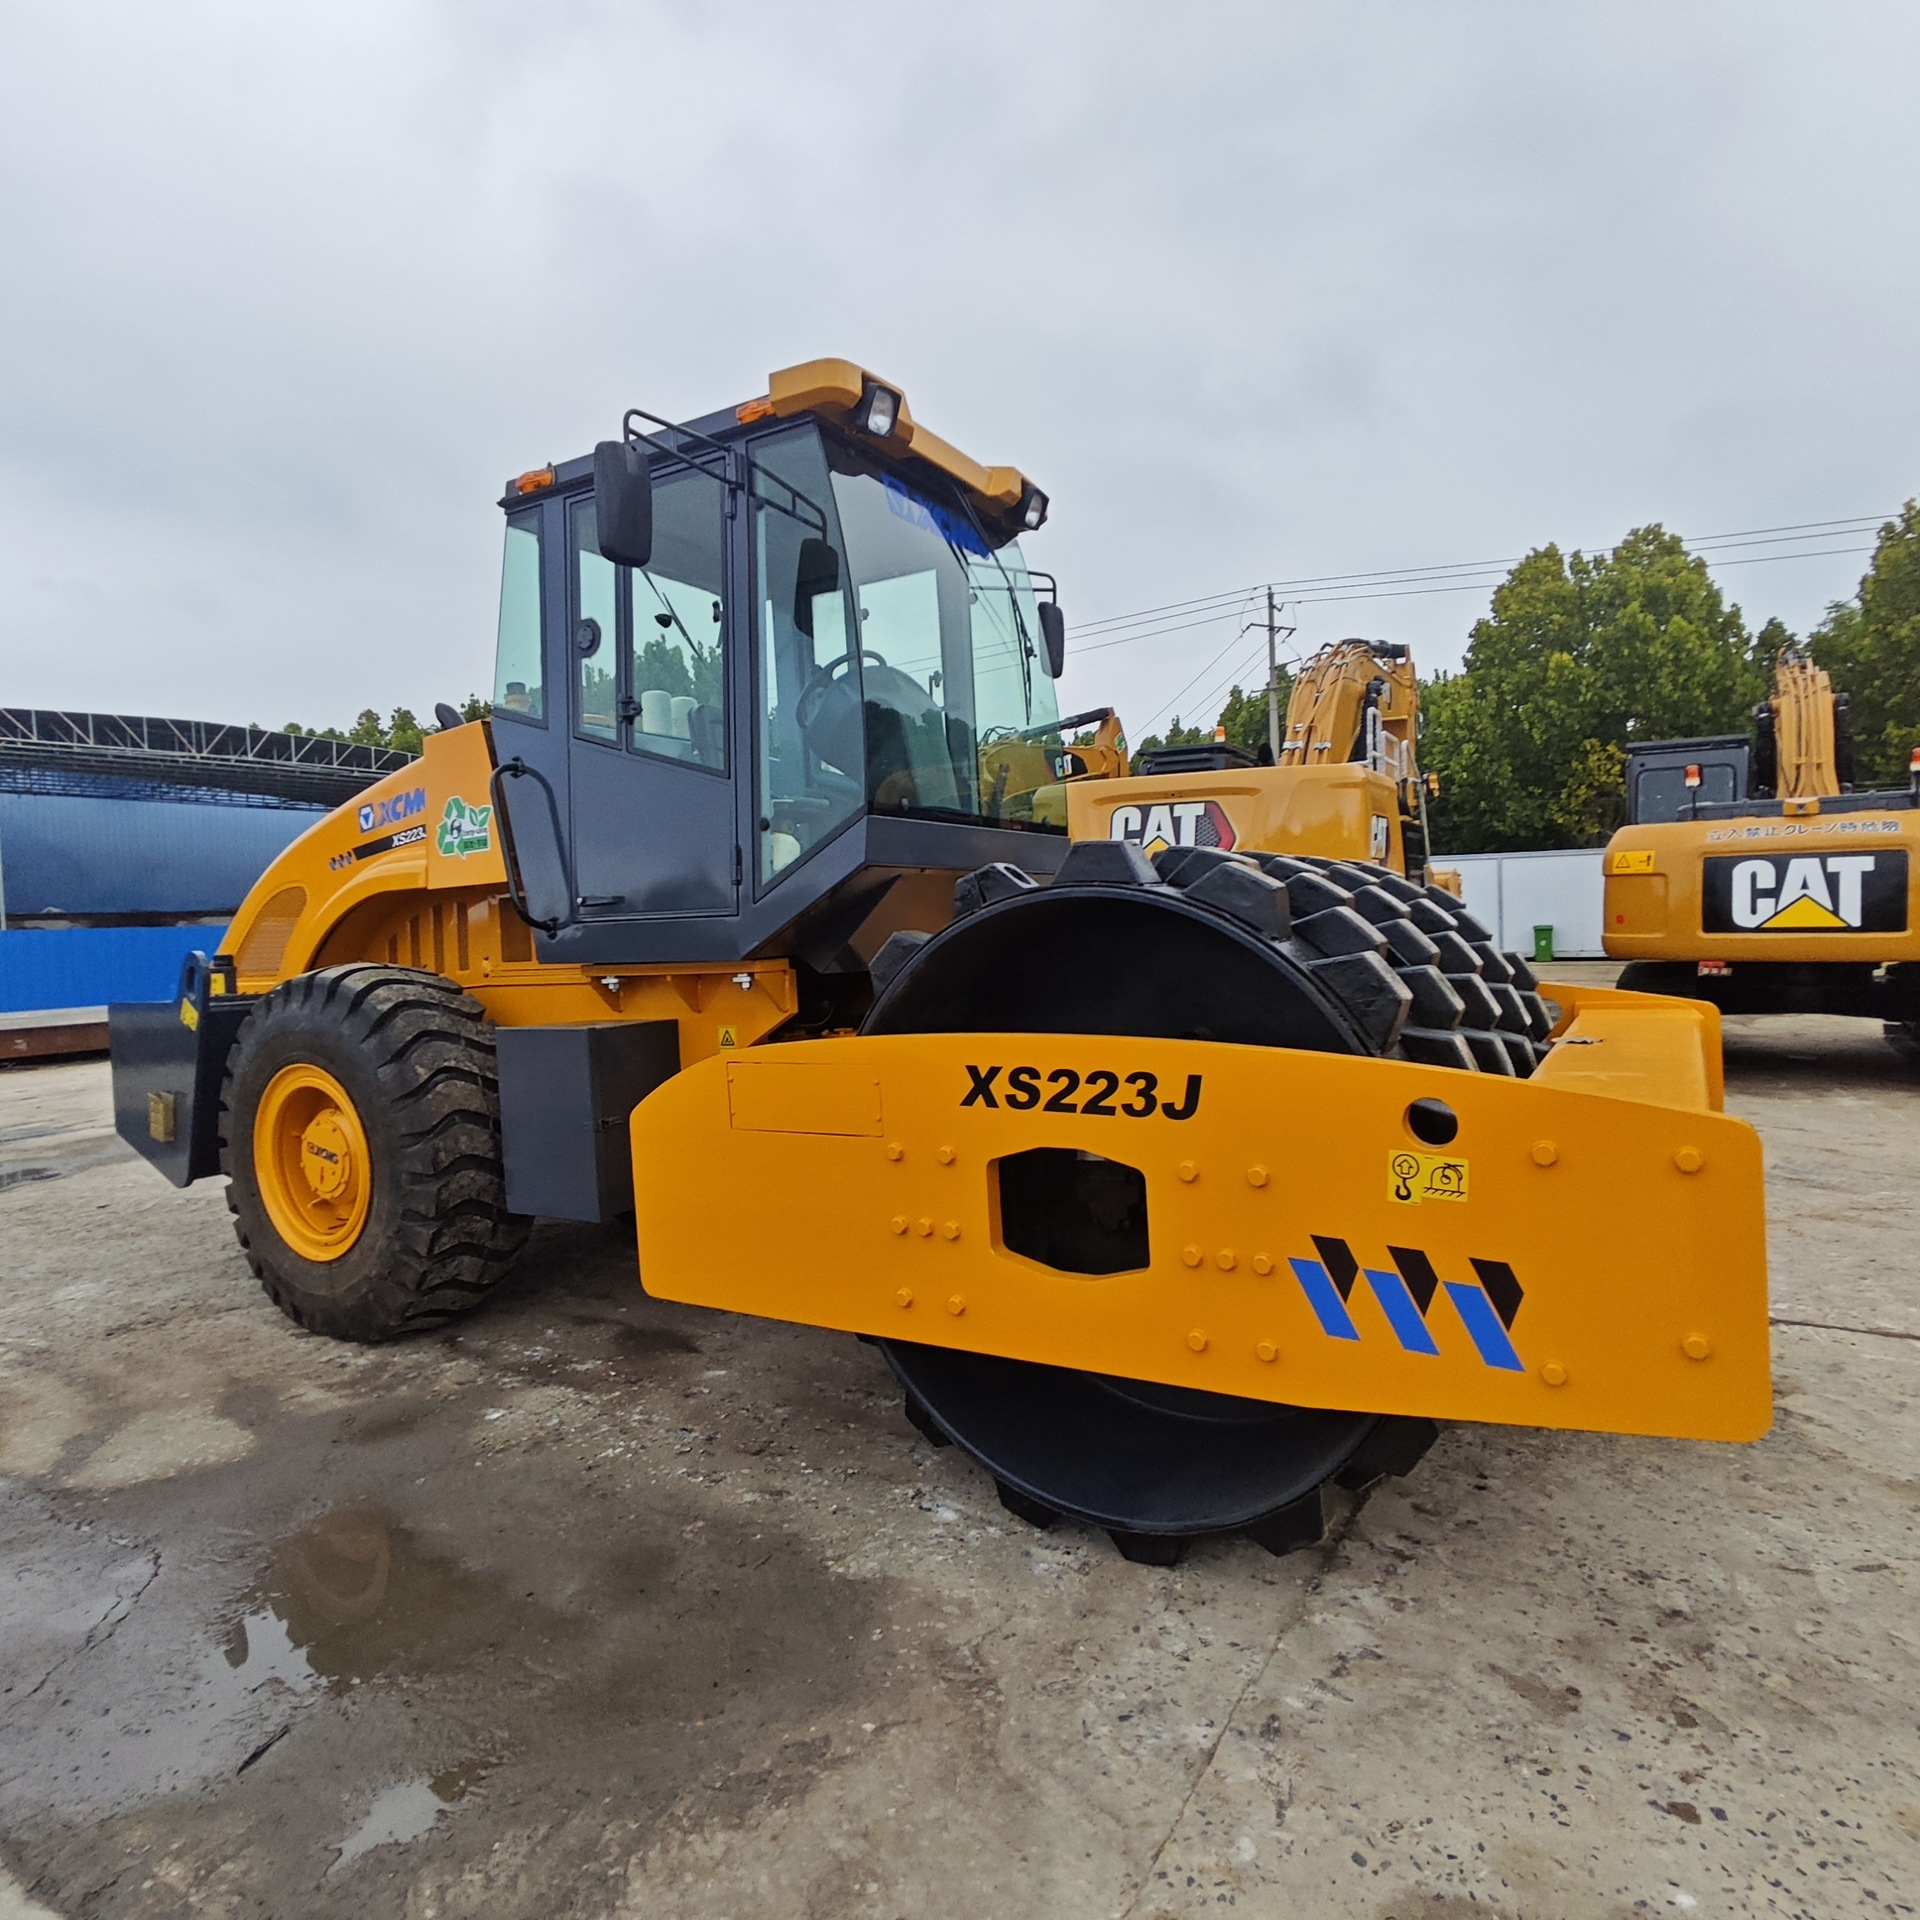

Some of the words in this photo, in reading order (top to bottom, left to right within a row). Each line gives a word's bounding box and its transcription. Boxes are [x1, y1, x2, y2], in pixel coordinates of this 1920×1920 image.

[377, 789, 425, 826] XCM
[1111, 803, 1205, 851] CAT
[1732, 856, 1875, 928] CAT
[959, 1065, 1202, 1120] XS223J
